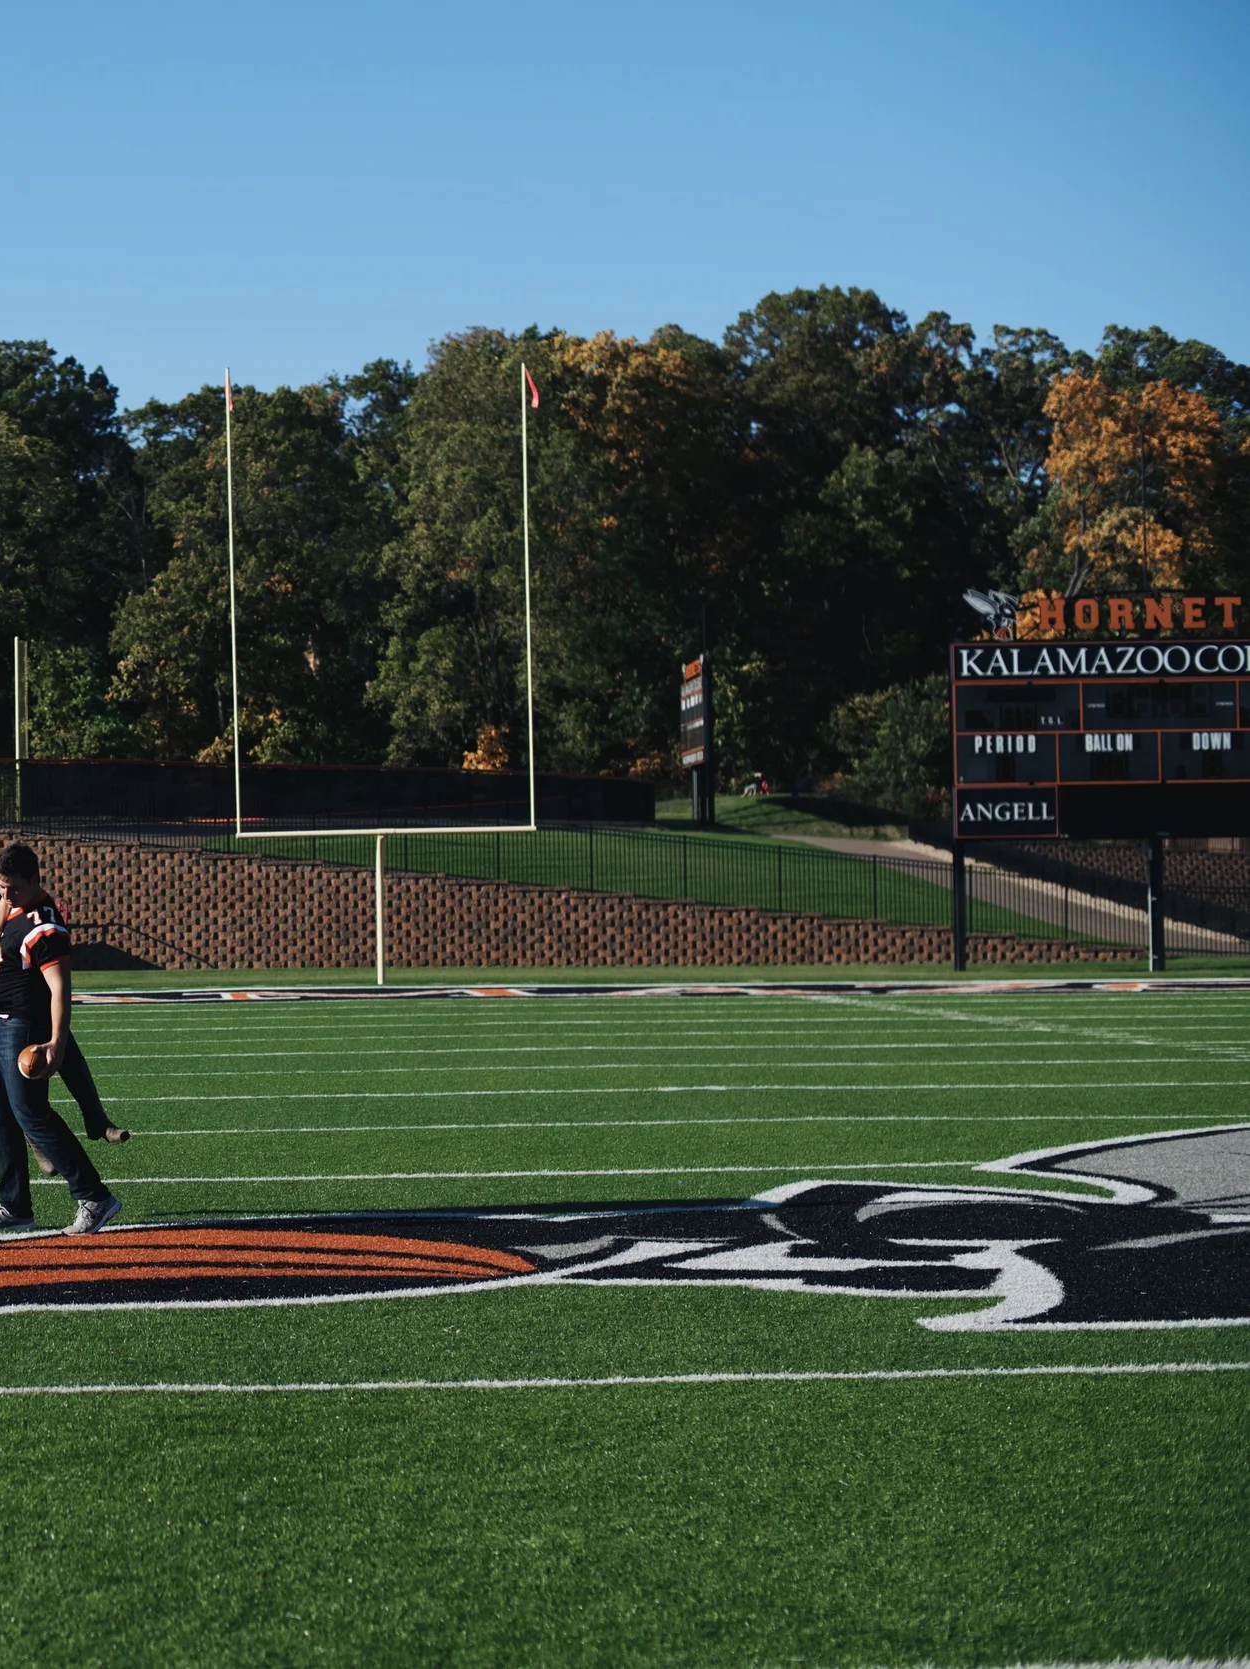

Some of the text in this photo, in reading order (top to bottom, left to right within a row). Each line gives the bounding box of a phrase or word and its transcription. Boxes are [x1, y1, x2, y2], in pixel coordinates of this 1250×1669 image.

[1038, 596, 1242, 630] HORNET
[959, 645, 1191, 677] KALAMAZOO
[974, 734, 1037, 754] PERIOD
[1085, 733, 1134, 753] BALL ON
[1192, 732, 1232, 751] DOWN
[959, 802, 1055, 822] ANGELL
